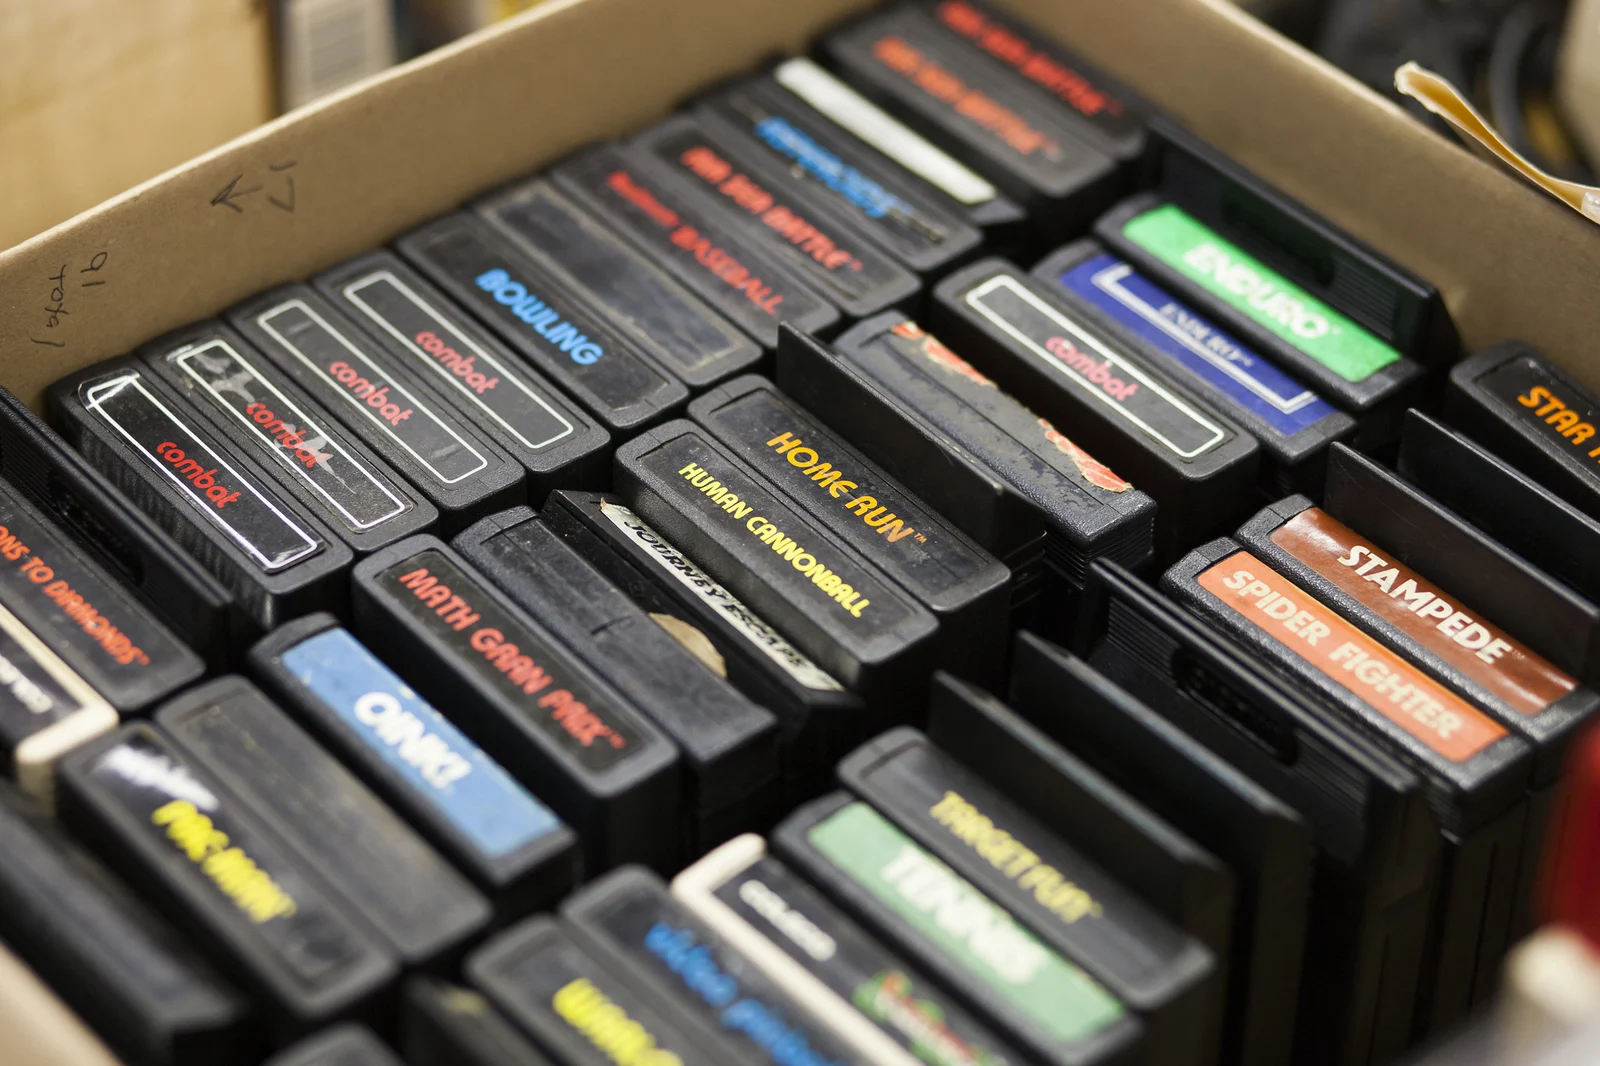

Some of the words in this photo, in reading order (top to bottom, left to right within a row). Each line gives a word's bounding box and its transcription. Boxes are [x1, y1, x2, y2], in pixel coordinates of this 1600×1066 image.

[671, 225, 783, 315] BASEBALL
[1184, 243, 1330, 339] ENDURO
[474, 267, 604, 366] BOWLING
[329, 361, 413, 426] combat
[415, 331, 499, 394] combat
[1045, 337, 1138, 401] combat
[245, 401, 330, 470] combat
[1517, 385, 1596, 446] STAR
[156, 440, 242, 509] combat
[766, 431, 859, 499] HOME
[624, 520, 726, 601] JOURNEY
[678, 462, 753, 520] HUMAN
[746, 516, 871, 618] CANNONBALL
[19, 556, 55, 584] TO
[43, 580, 136, 665] DIAMONDS
[398, 567, 481, 632] MATH
[470, 627, 553, 695] GRAN
[1223, 570, 1331, 647] SPIDER
[1328, 641, 1462, 739] FIGHTER
